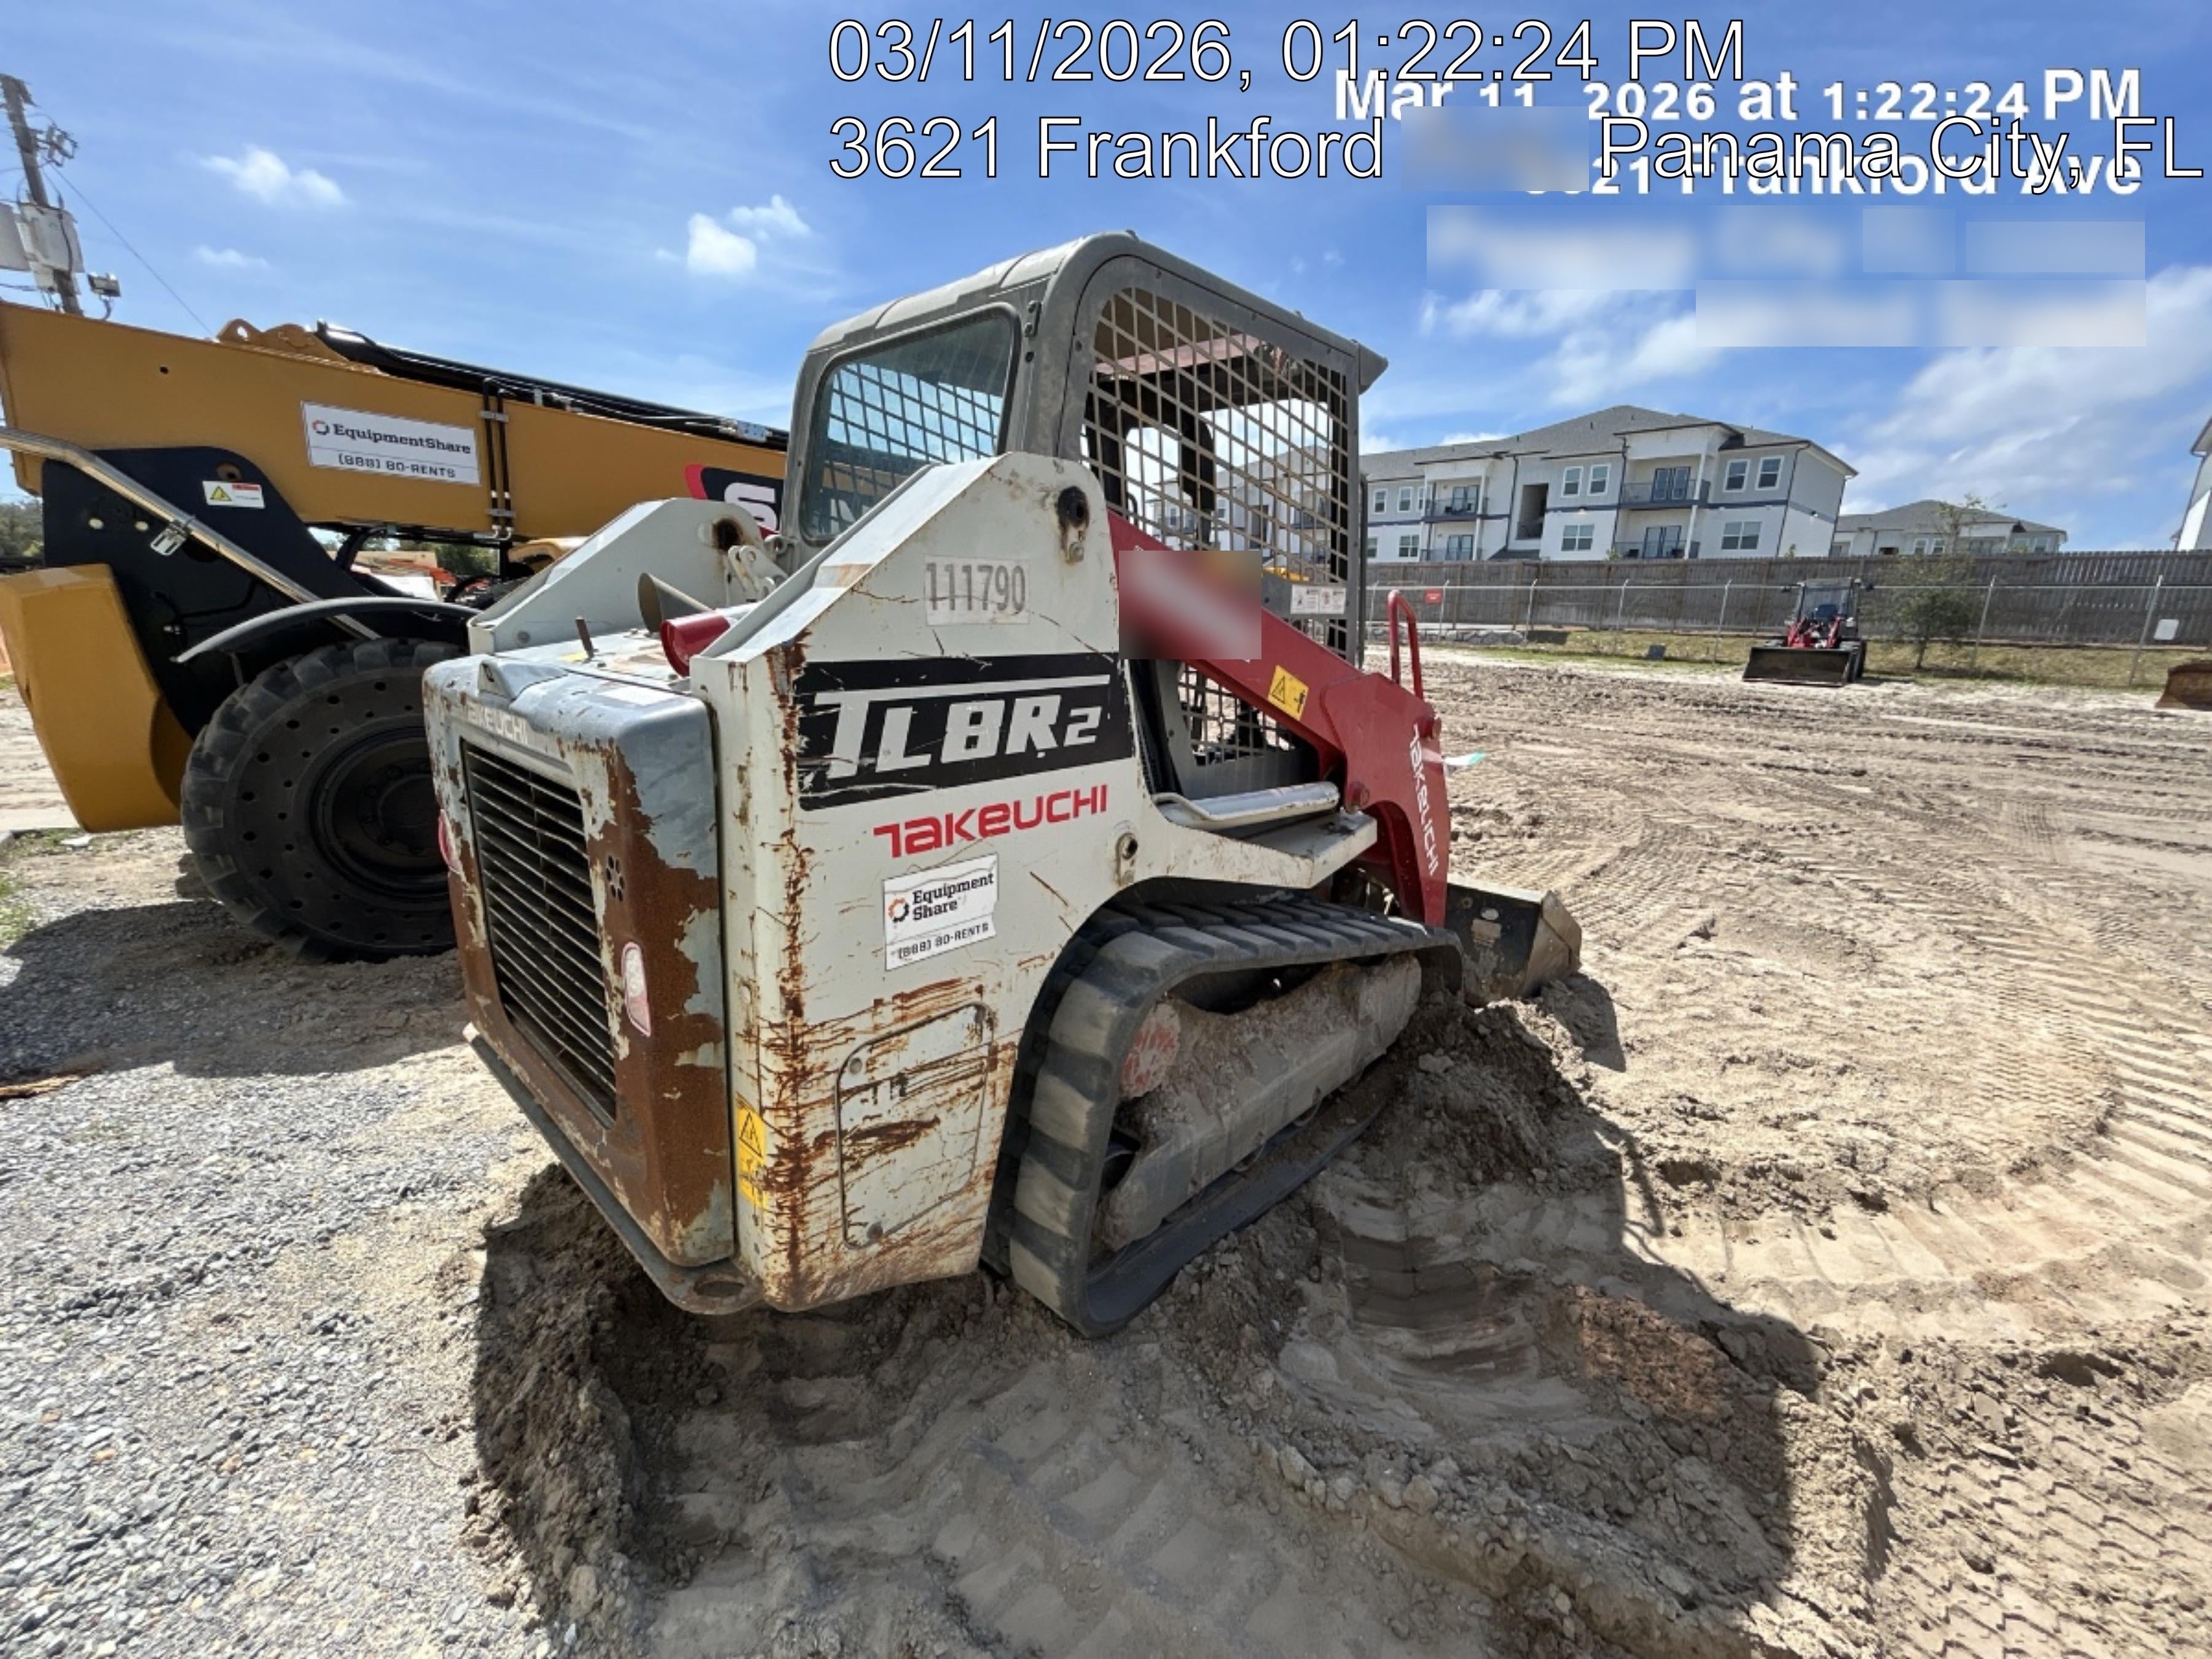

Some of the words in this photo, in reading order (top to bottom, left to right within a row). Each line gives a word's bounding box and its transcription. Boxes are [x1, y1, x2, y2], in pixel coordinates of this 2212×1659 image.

[332, 423, 471, 454] EquipmentShare
[926, 562, 1026, 613] 111790
[912, 873, 994, 906] Equipment
[912, 900, 958, 921] Share
